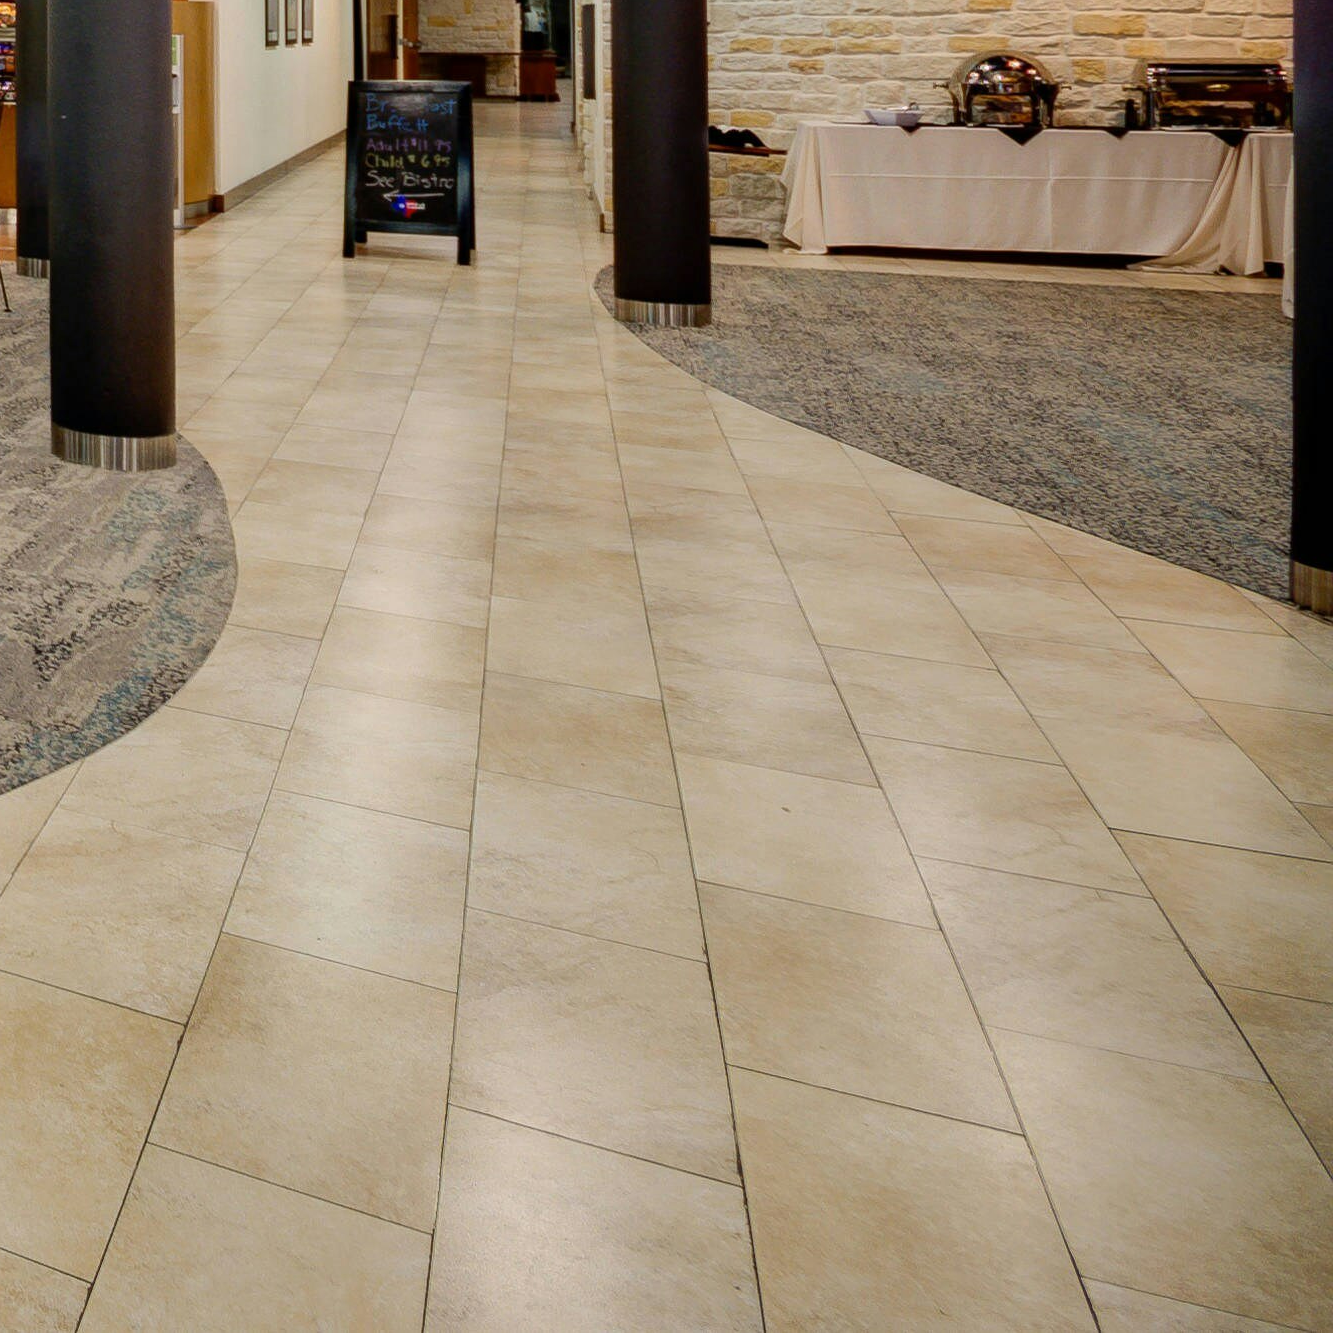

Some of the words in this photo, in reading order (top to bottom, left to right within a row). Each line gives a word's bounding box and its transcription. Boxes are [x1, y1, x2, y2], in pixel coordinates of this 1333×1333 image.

[366, 93, 457, 114] Brast
[365, 170, 395, 188] See
[400, 170, 454, 189] Bistro
